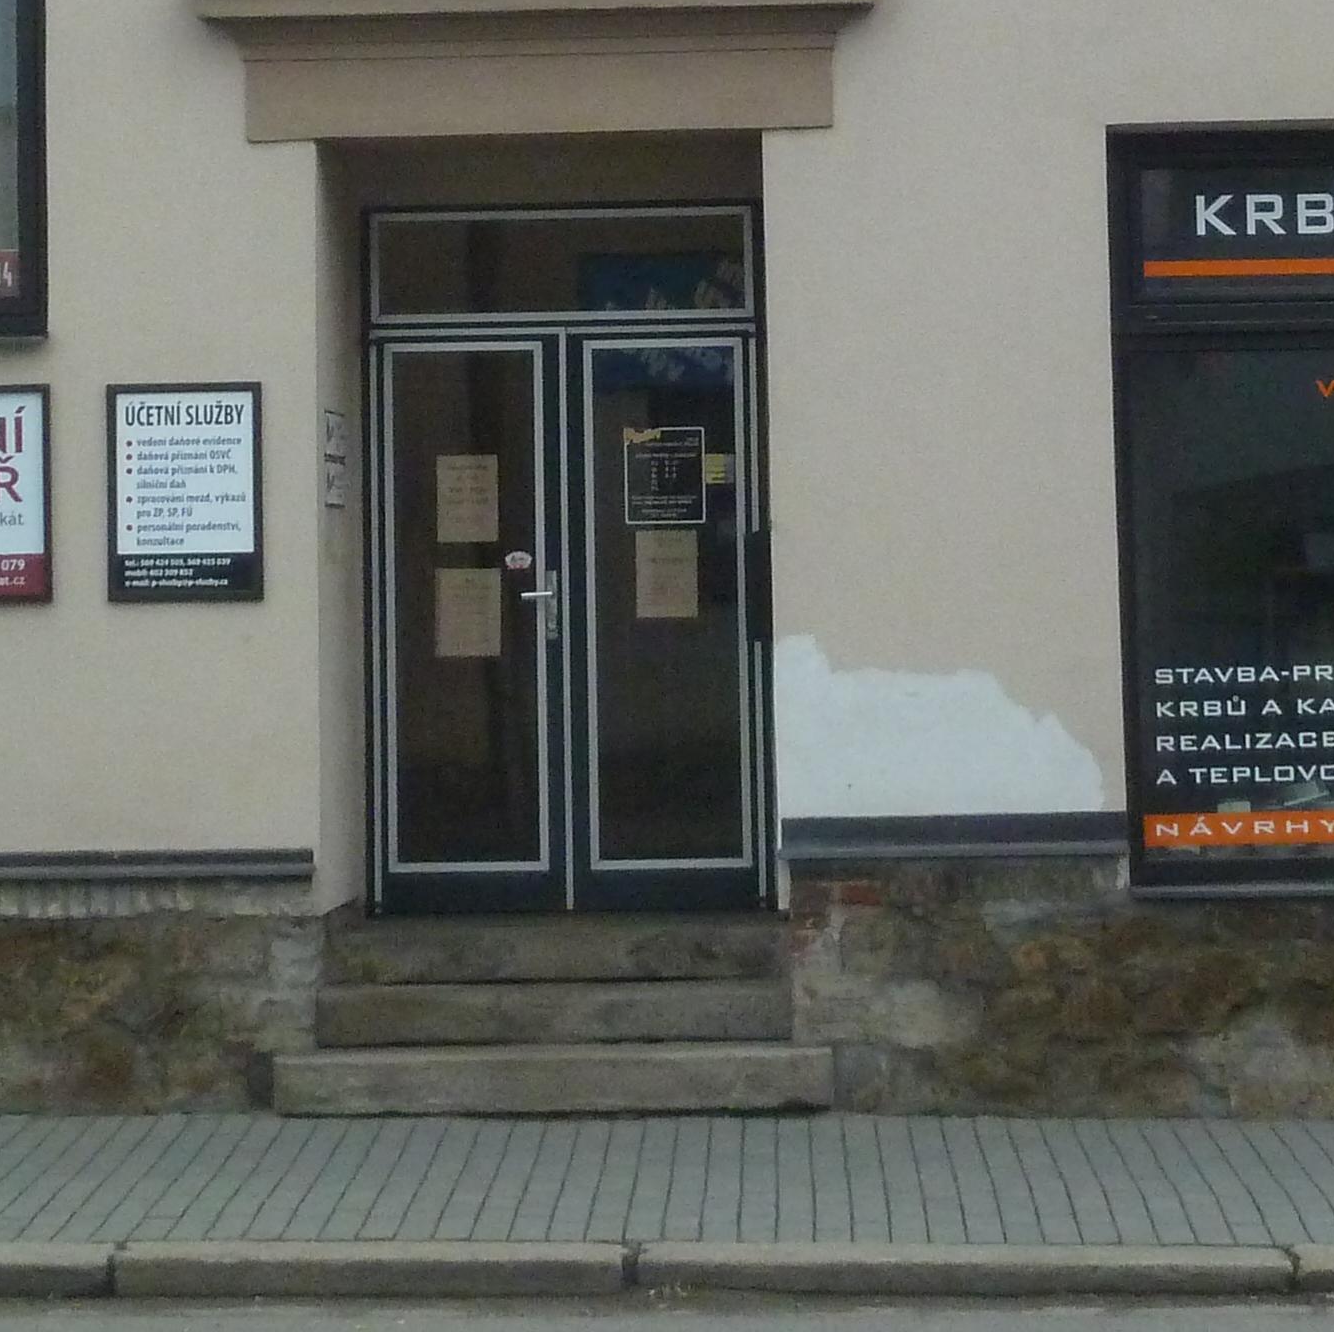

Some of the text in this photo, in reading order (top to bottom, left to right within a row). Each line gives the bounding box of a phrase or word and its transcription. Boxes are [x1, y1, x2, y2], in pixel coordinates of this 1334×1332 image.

[125, 400, 245, 426] ÚČETNÍ SLUŽBY
[0, 558, 25, 571] 079
[1156, 695, 1246, 717] KRBŮ
[1261, 700, 1282, 715] A
[1156, 769, 1177, 785] A
